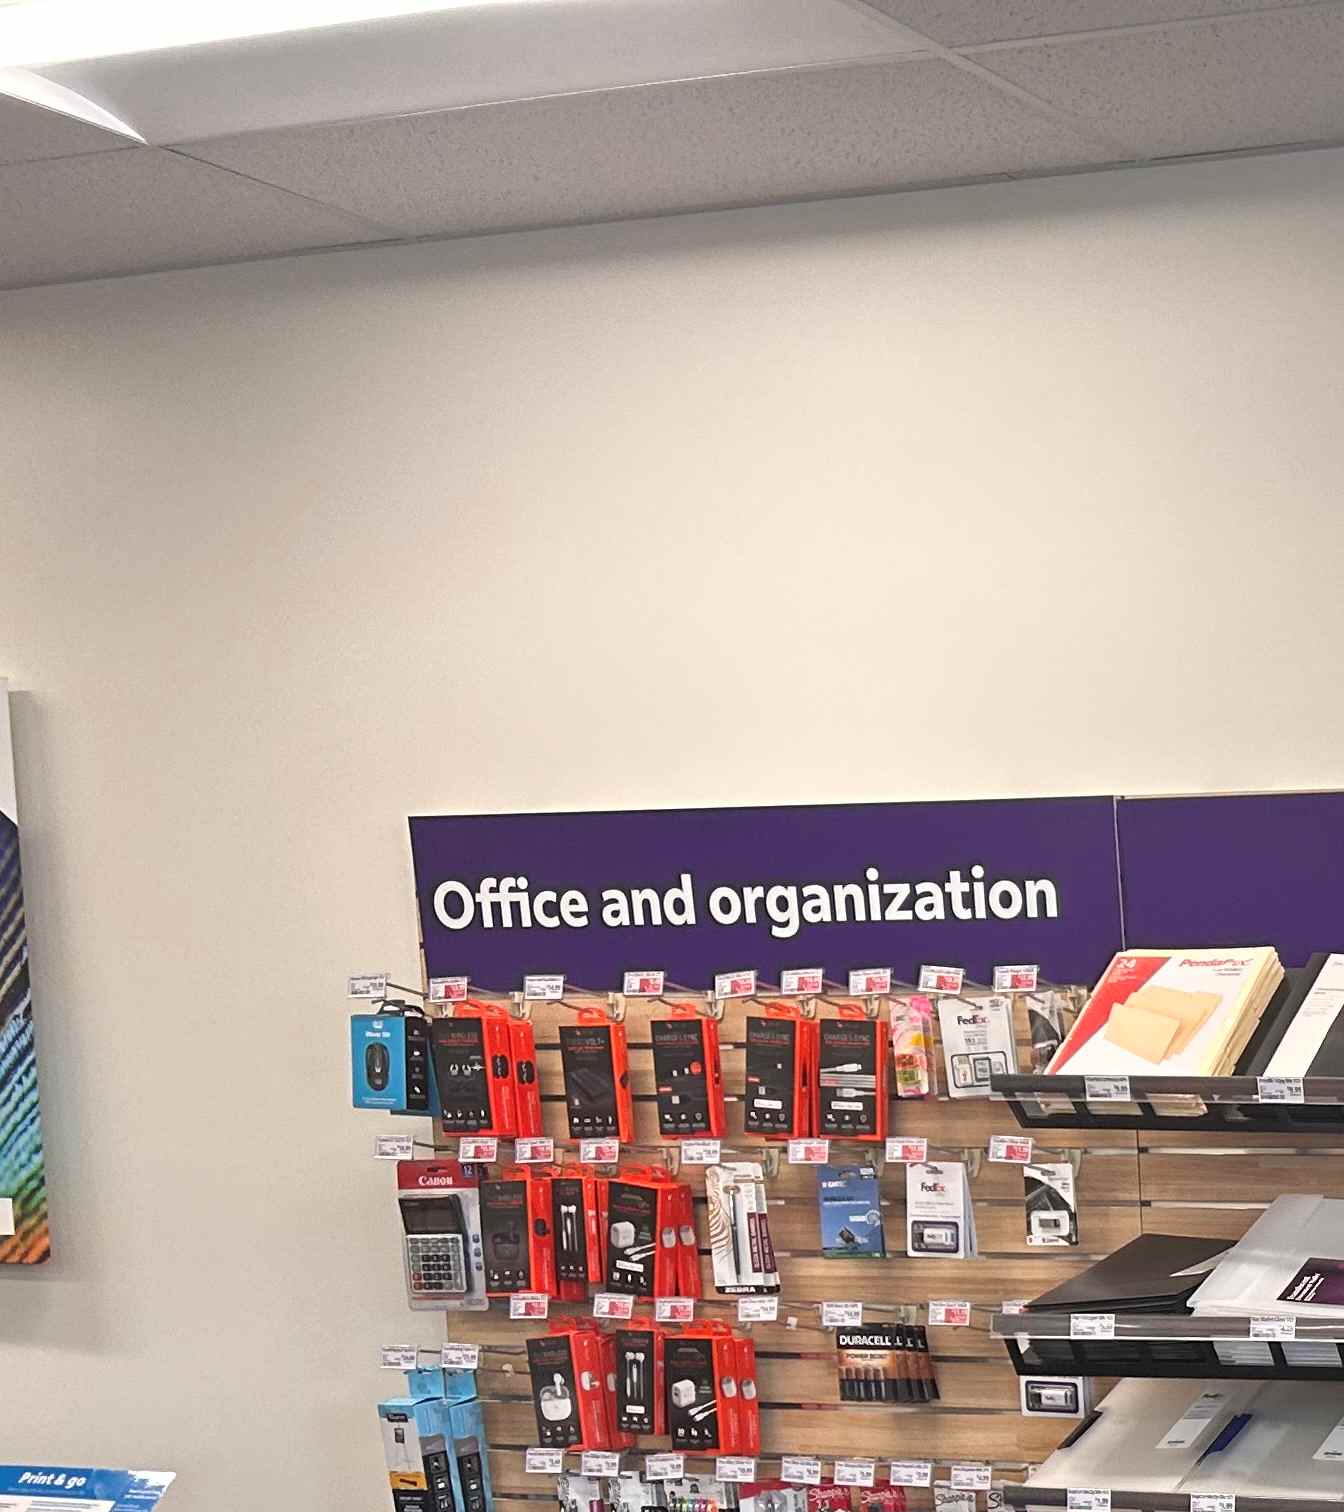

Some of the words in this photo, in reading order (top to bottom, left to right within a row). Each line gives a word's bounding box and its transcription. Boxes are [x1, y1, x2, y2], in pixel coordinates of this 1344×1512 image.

[434, 875, 589, 931] Office
[601, 873, 696, 928] and
[713, 865, 1057, 937] organization
[418, 1176, 453, 1186] Canon
[920, 1182, 945, 1193] FedEx
[838, 1334, 892, 1346] DURACELL
[18, 1471, 52, 1484] Print
[65, 1477, 87, 1489] go
